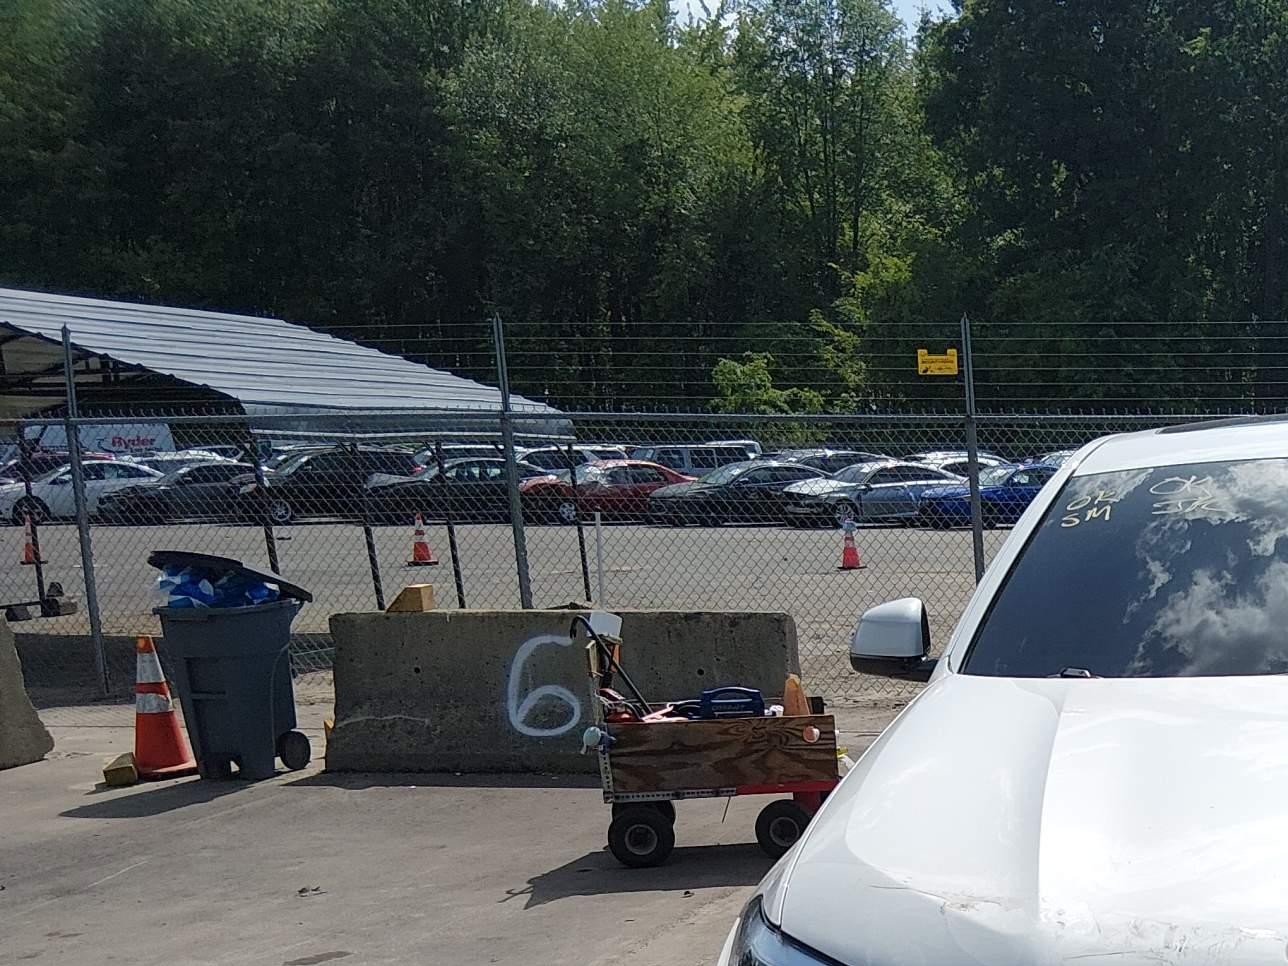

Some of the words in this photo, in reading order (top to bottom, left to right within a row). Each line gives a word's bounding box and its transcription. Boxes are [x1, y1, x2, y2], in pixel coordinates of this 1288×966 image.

[111, 436, 156, 449] Ryder
[1066, 490, 1120, 511] OK
[1061, 505, 1112, 528] SM
[508, 634, 581, 737] 6
